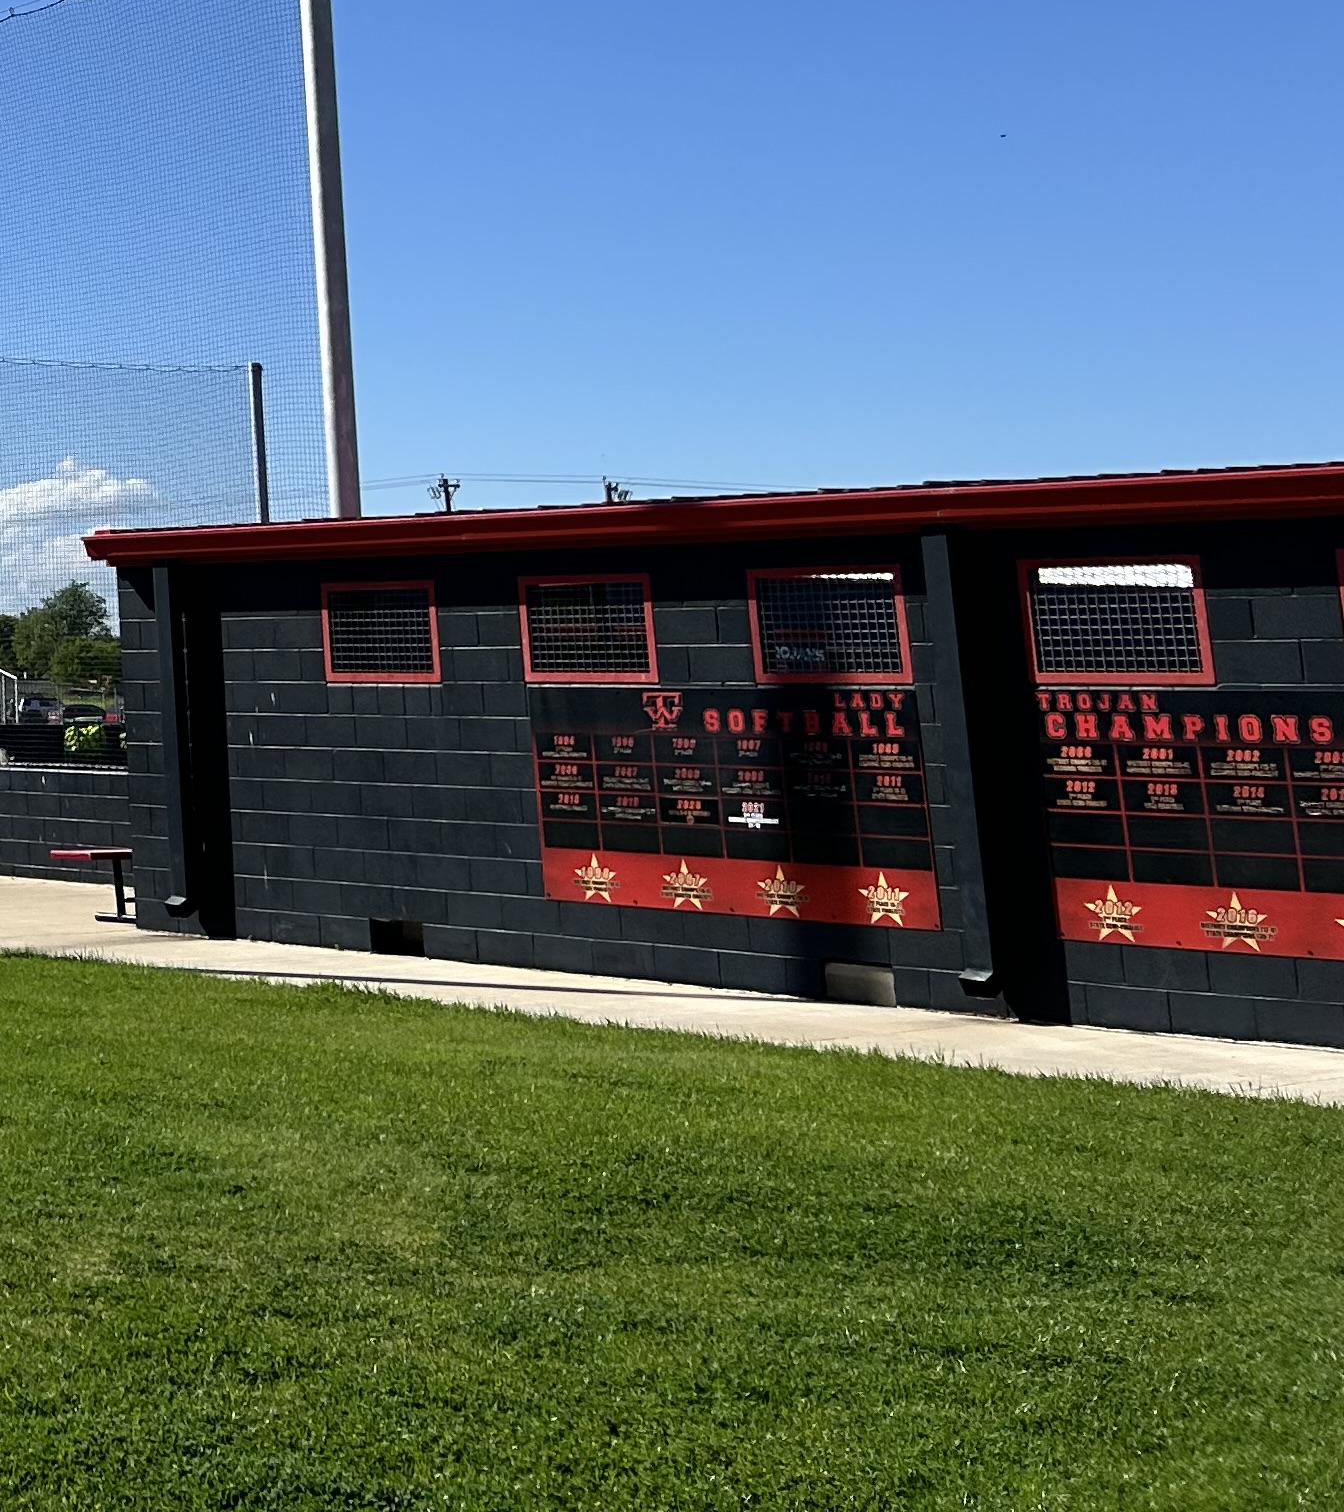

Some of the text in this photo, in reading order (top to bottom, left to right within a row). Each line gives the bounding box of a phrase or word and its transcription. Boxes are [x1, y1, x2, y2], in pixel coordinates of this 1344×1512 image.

[834, 692, 905, 710] LADY
[1036, 691, 1159, 712] TROJAN
[703, 708, 905, 737] SOFTBALL
[1045, 712, 1333, 745] CHAMPIONS
[1226, 750, 1261, 762] 2002
[1066, 781, 1096, 793] 2012
[669, 872, 701, 887] 2007
[763, 878, 798, 894] 2010
[866, 885, 900, 901] 2011
[1094, 899, 1133, 916] 2012
[1215, 906, 1259, 925] 2016
